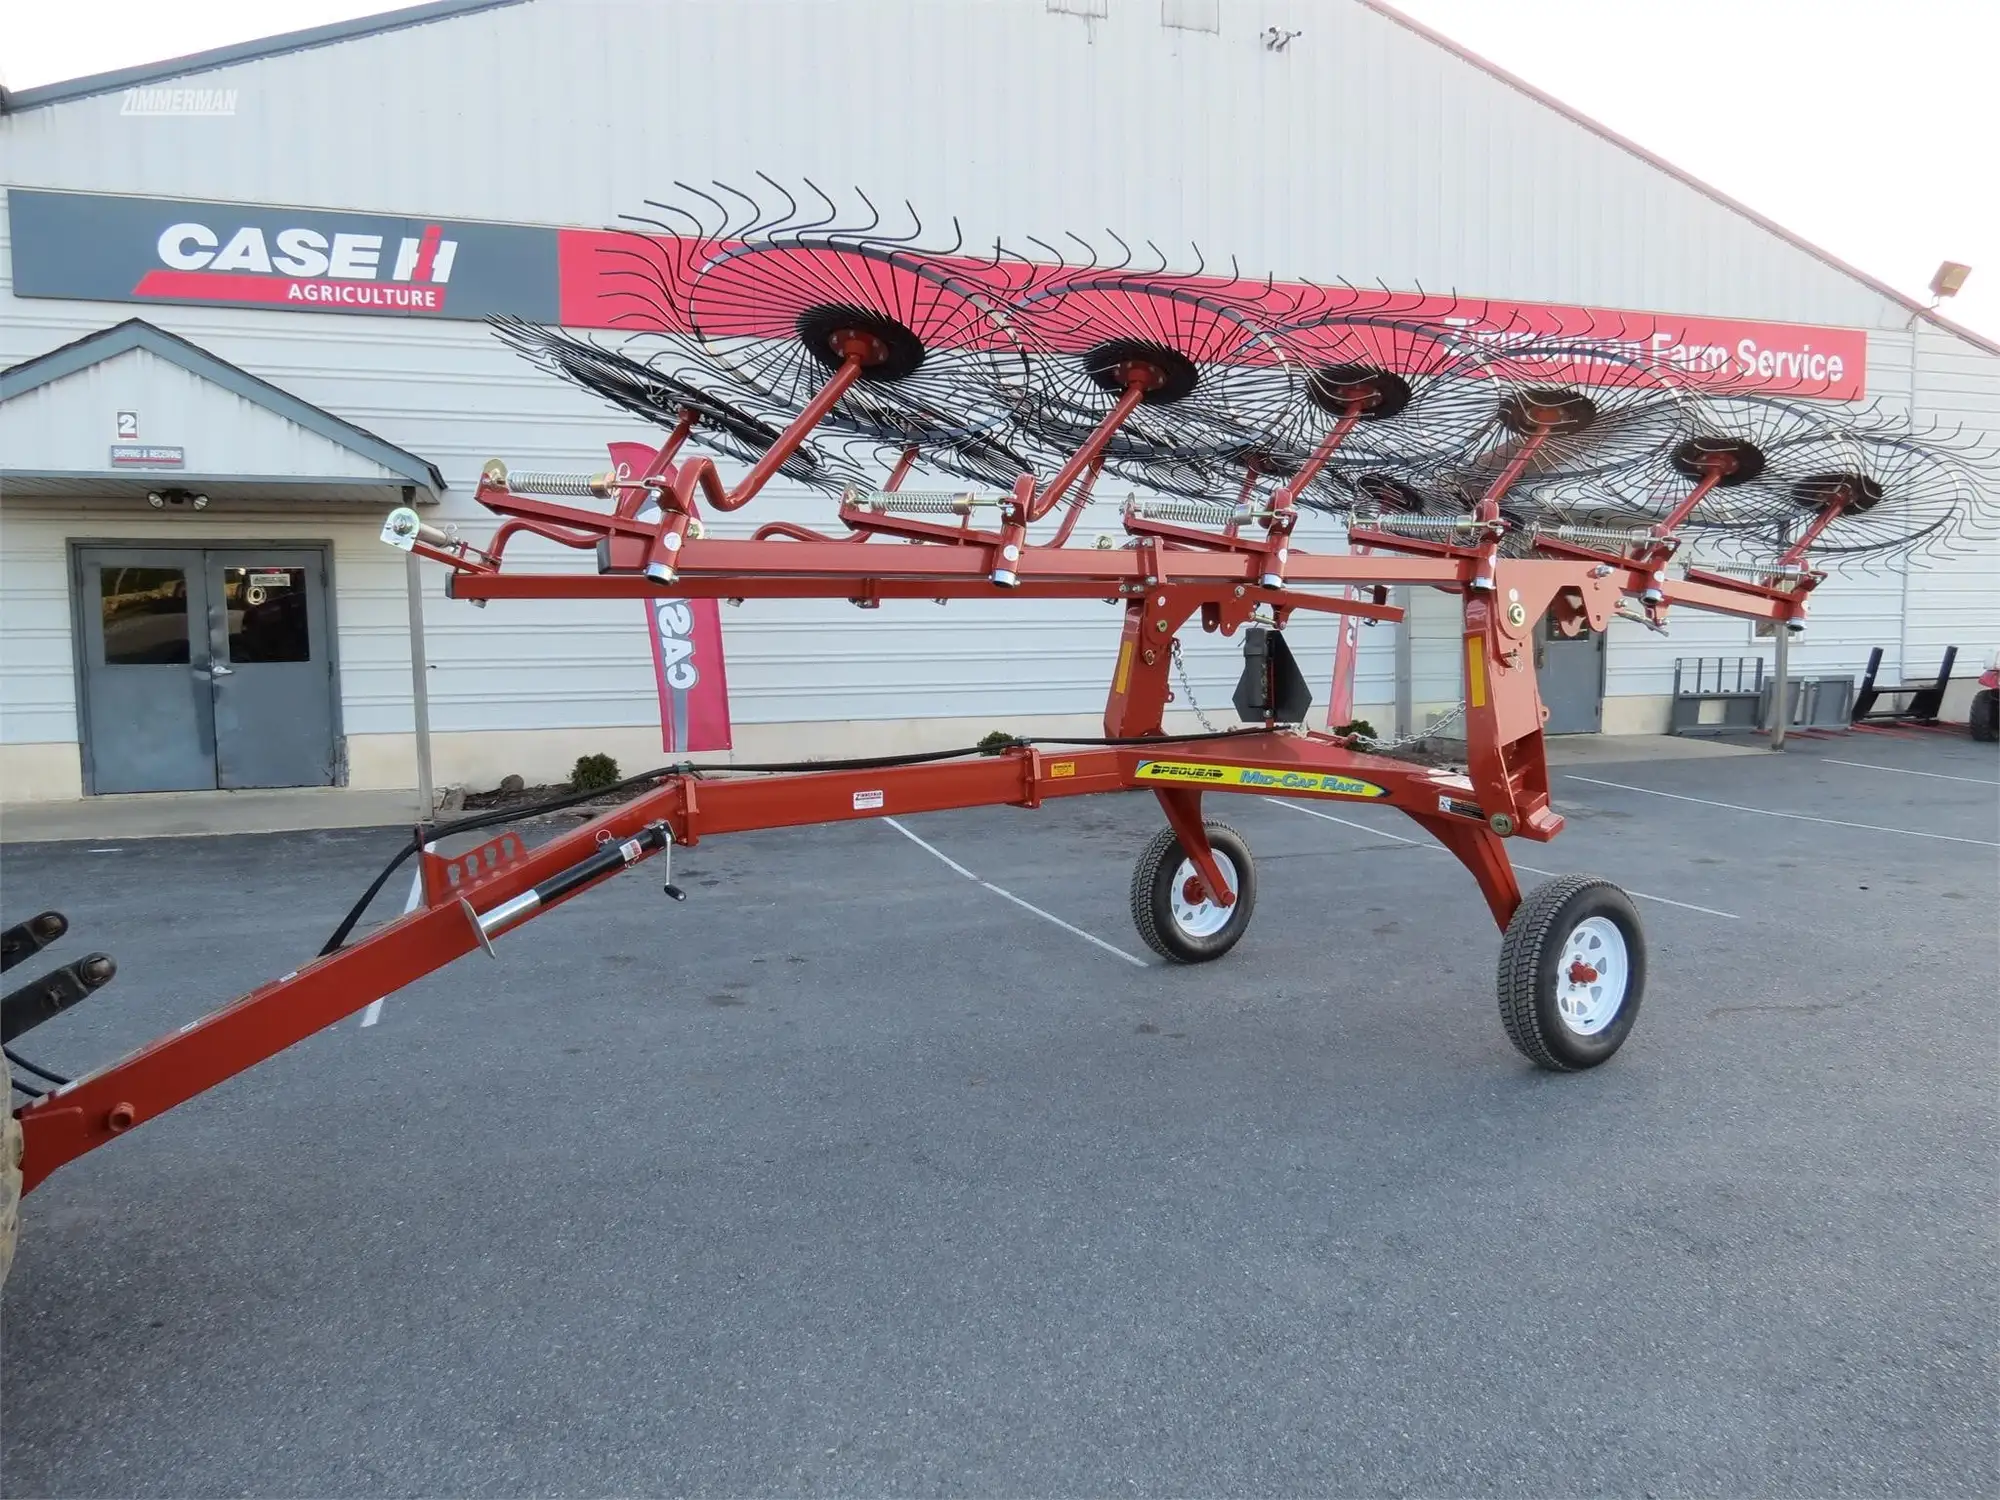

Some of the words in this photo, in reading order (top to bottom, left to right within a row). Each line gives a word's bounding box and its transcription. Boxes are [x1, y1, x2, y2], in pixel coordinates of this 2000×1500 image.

[157, 222, 383, 280] CASE
[392, 225, 458, 283] IH
[288, 283, 436, 308] AGRICULTURE
[1651, 332, 1728, 375] Farm
[1736, 338, 1844, 382] Service
[118, 414, 136, 434] 2
